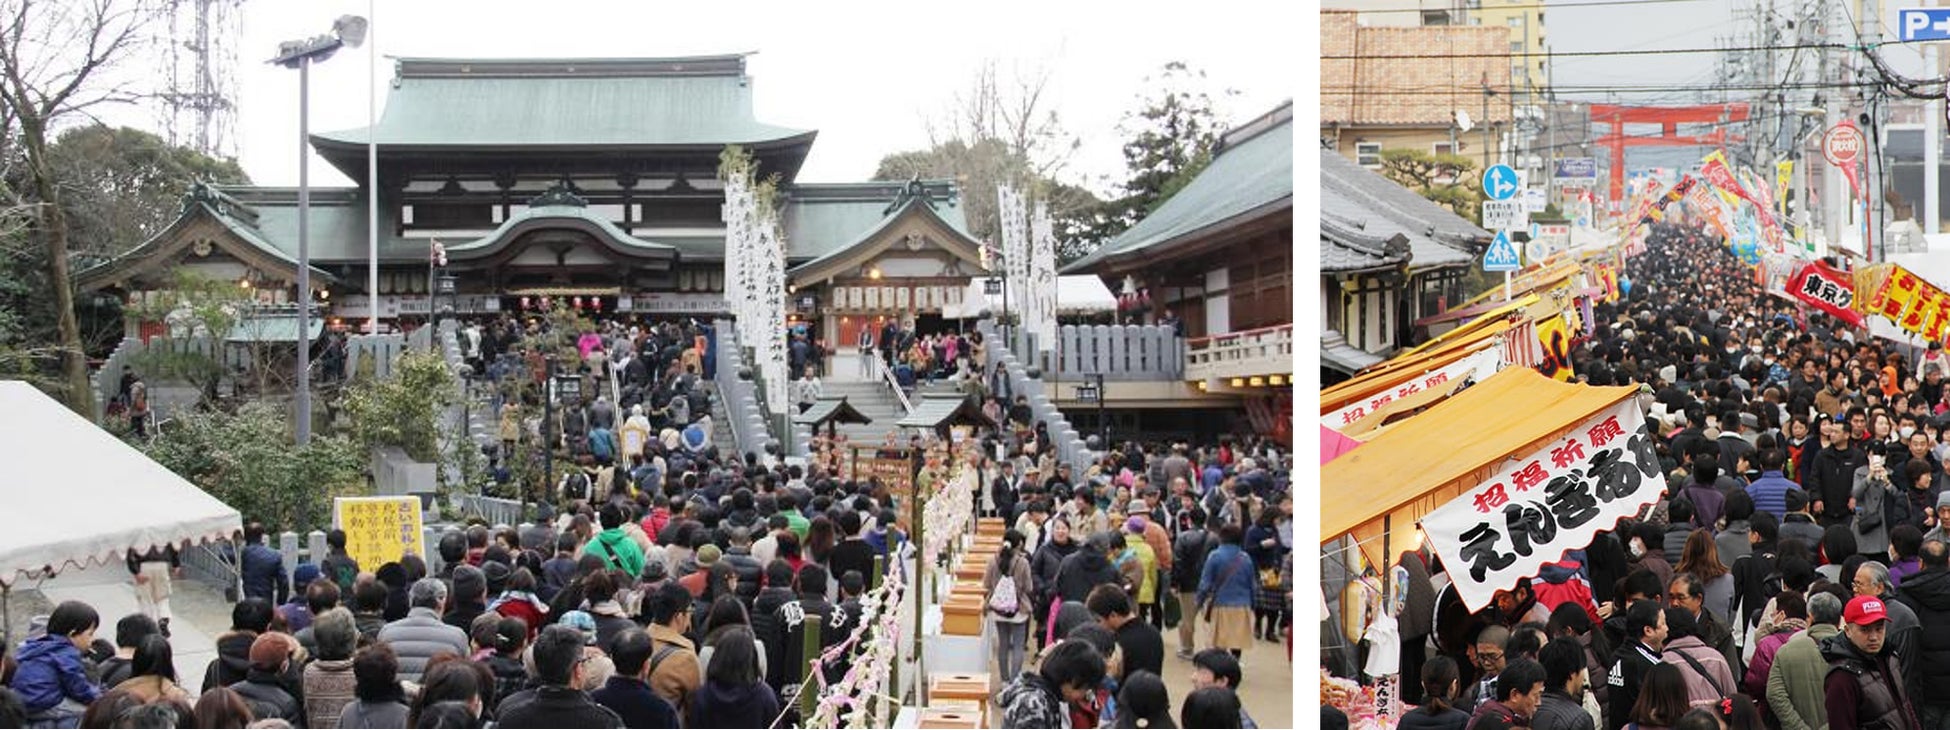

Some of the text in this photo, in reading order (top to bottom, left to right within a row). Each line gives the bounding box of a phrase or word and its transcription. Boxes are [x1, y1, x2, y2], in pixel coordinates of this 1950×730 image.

[1906, 12, 1930, 40] P
[1473, 415, 1626, 513] 招福祈願
